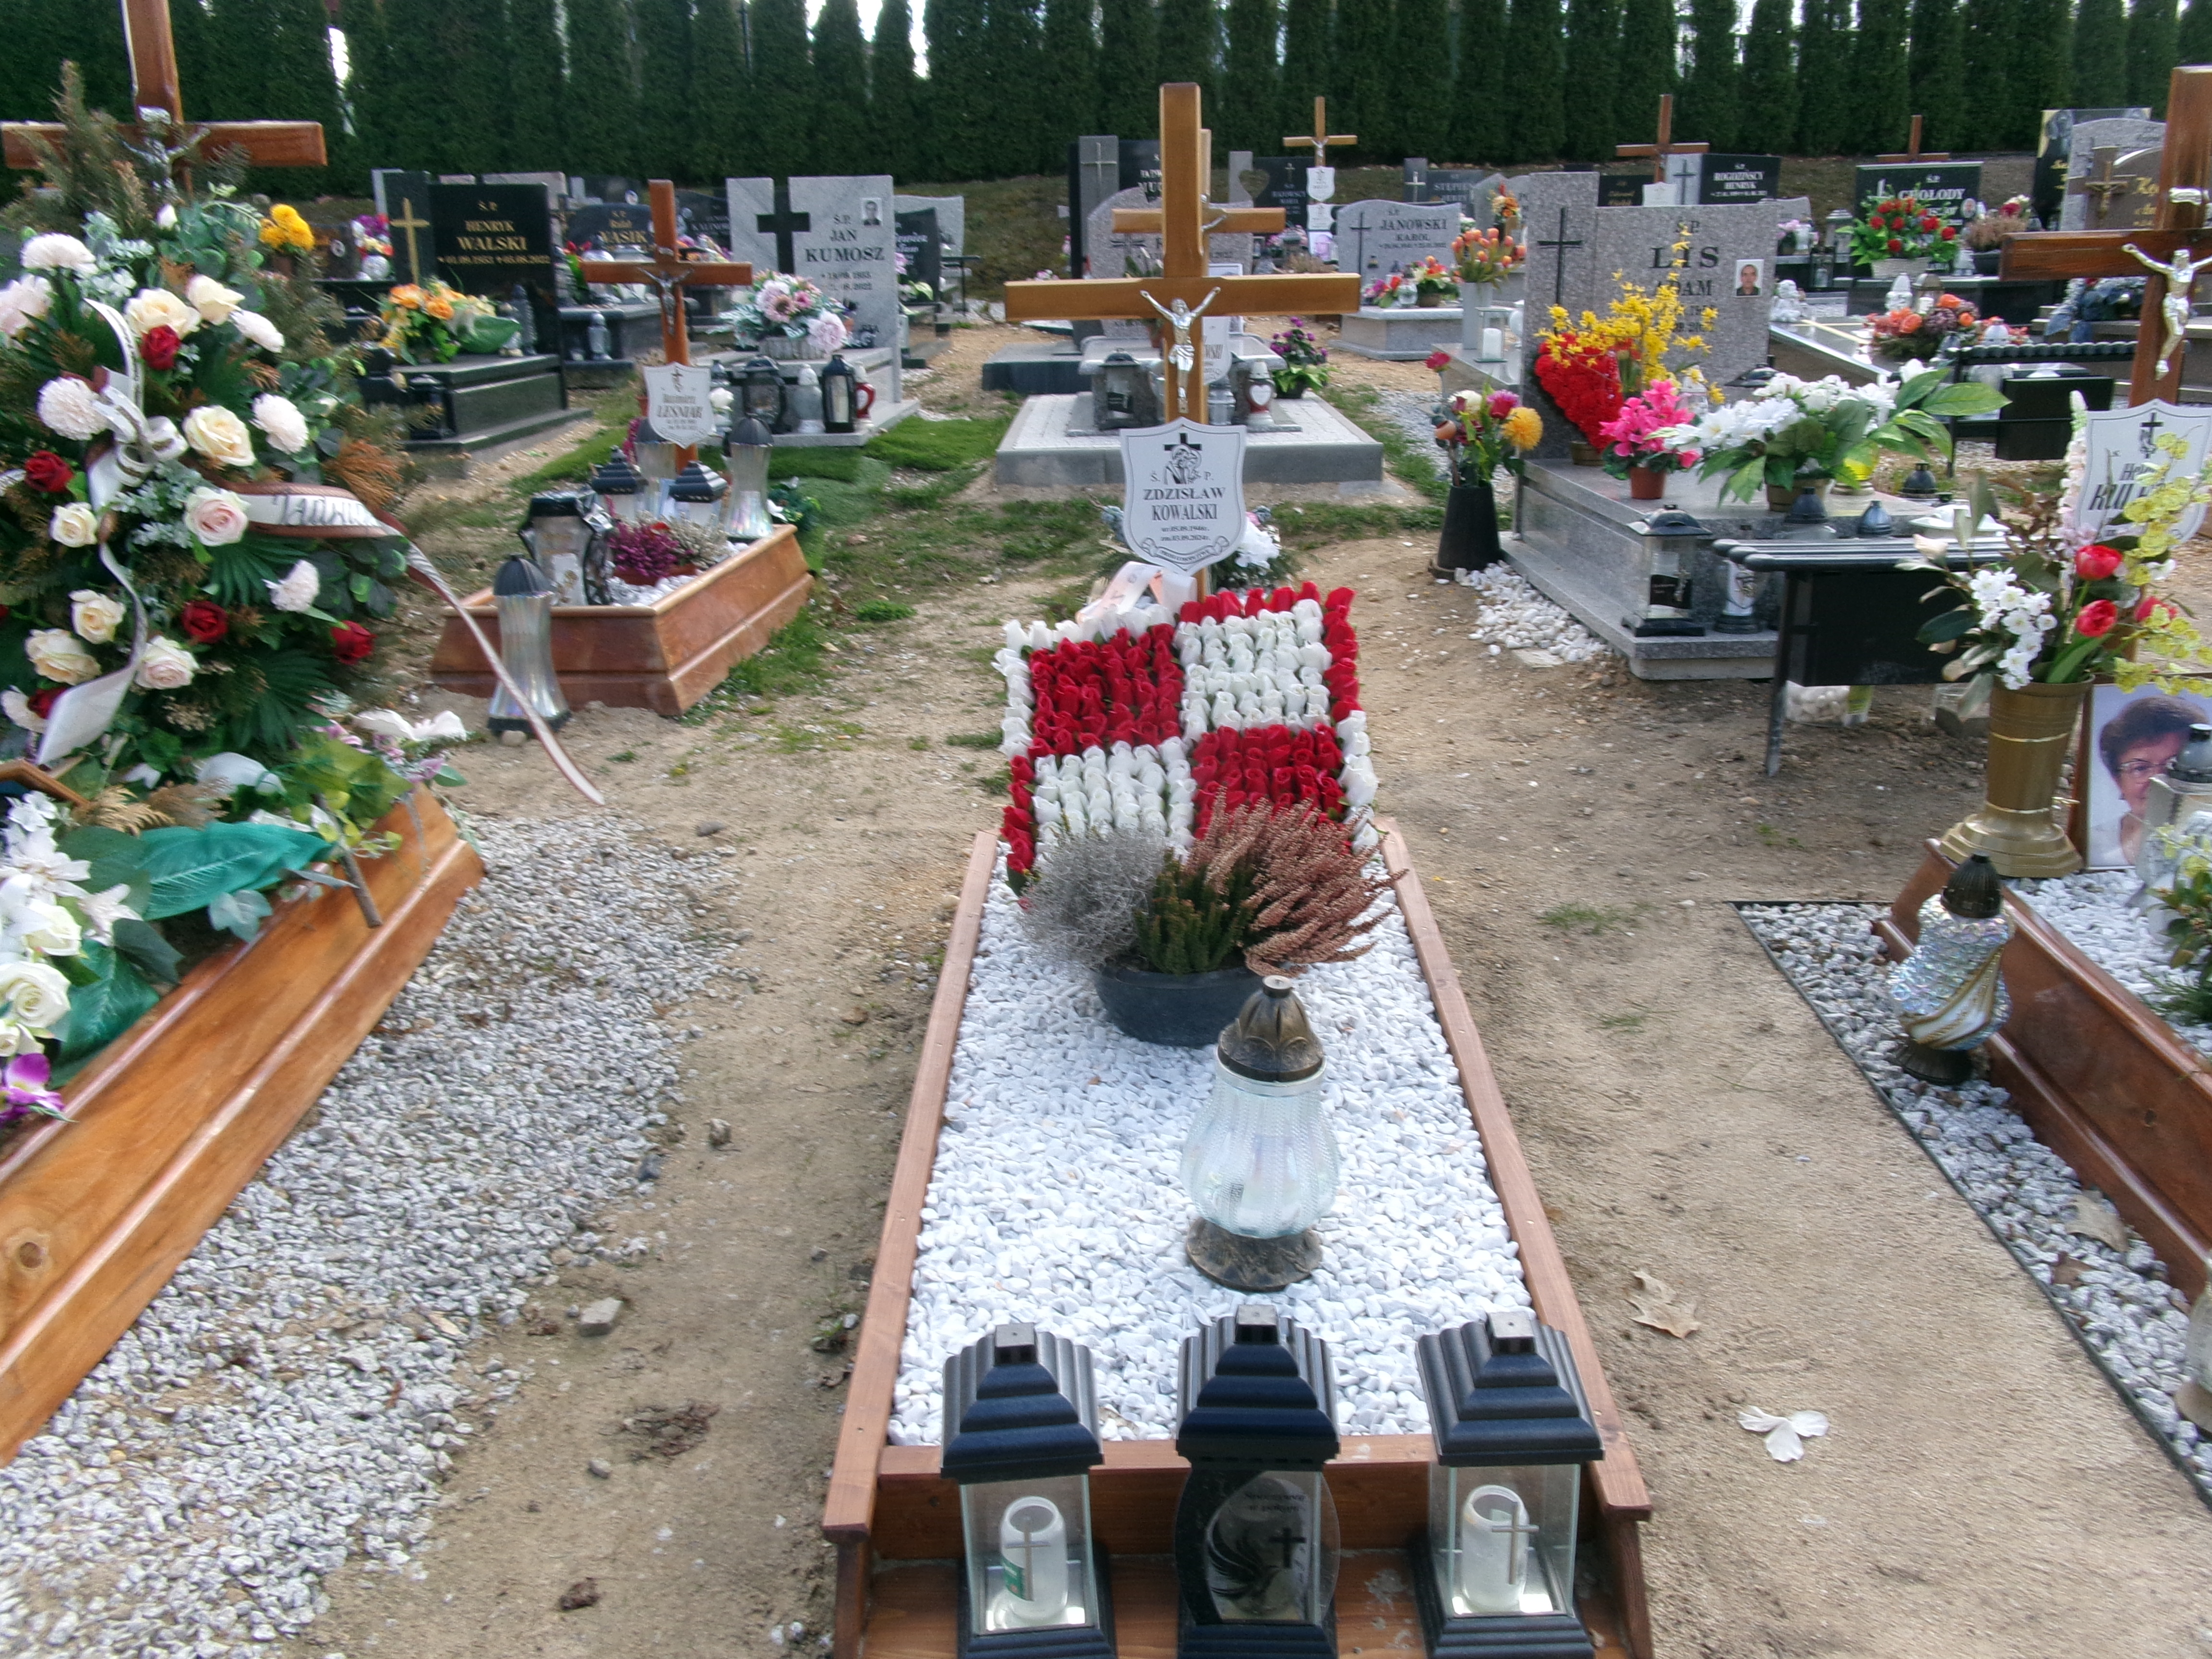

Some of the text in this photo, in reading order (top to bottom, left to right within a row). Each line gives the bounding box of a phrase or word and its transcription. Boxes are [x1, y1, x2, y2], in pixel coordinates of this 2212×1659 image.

[1379, 218, 1447, 231] JANOWSKI
[829, 229, 857, 241] JAN
[456, 236, 528, 251] WALSKI
[804, 246, 886, 263] KUMOSZ
[1648, 246, 1719, 268] LIS
[1142, 486, 1226, 500] ZDZISŁAW
[1152, 504, 1218, 521] KOWALSKI
